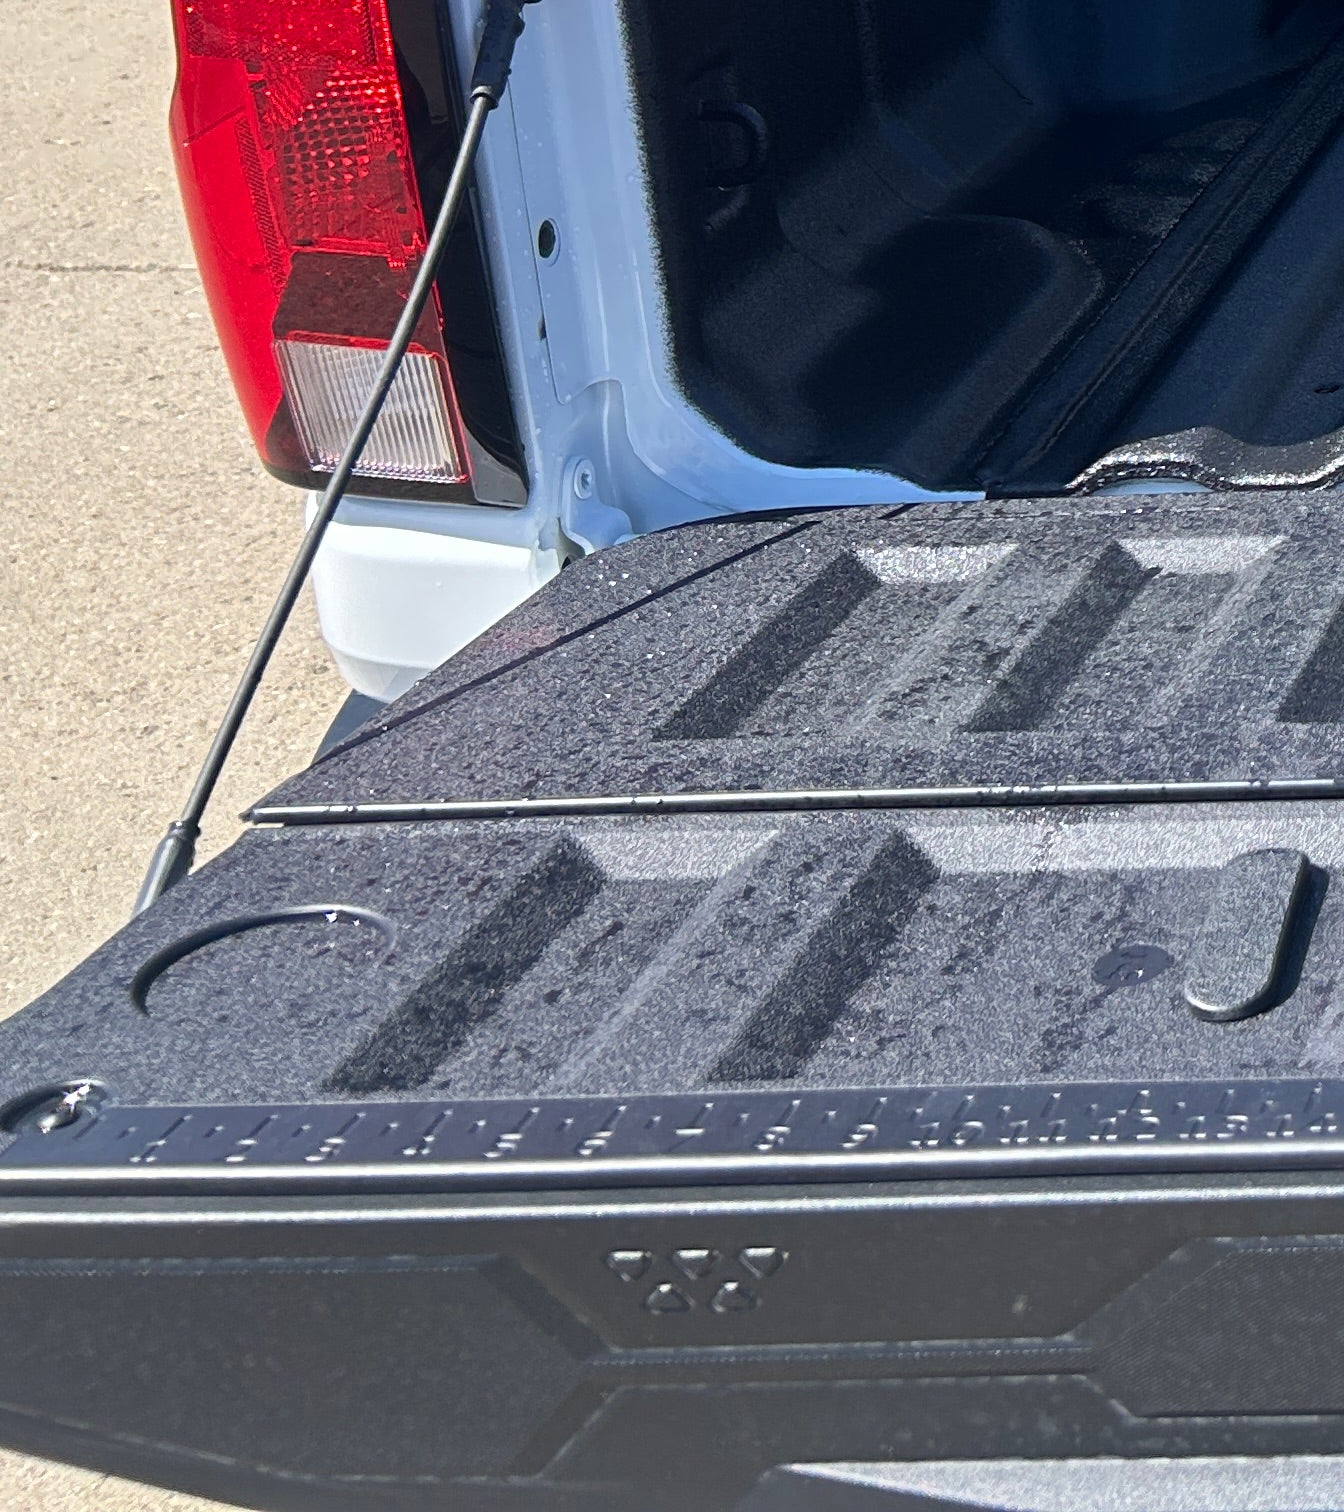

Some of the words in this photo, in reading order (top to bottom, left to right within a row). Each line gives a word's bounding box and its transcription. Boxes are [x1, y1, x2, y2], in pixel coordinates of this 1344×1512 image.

[482, 1132, 524, 1158] 5
[575, 1130, 614, 1156] 6
[665, 1127, 706, 1154] 7
[755, 1125, 791, 1150] 8
[841, 1123, 879, 1149] 9
[908, 1120, 986, 1146] 10
[1000, 1118, 1068, 1144] 11
[1087, 1115, 1161, 1141] 12
[1179, 1115, 1249, 1140] 13
[1265, 1112, 1337, 1138] 14
